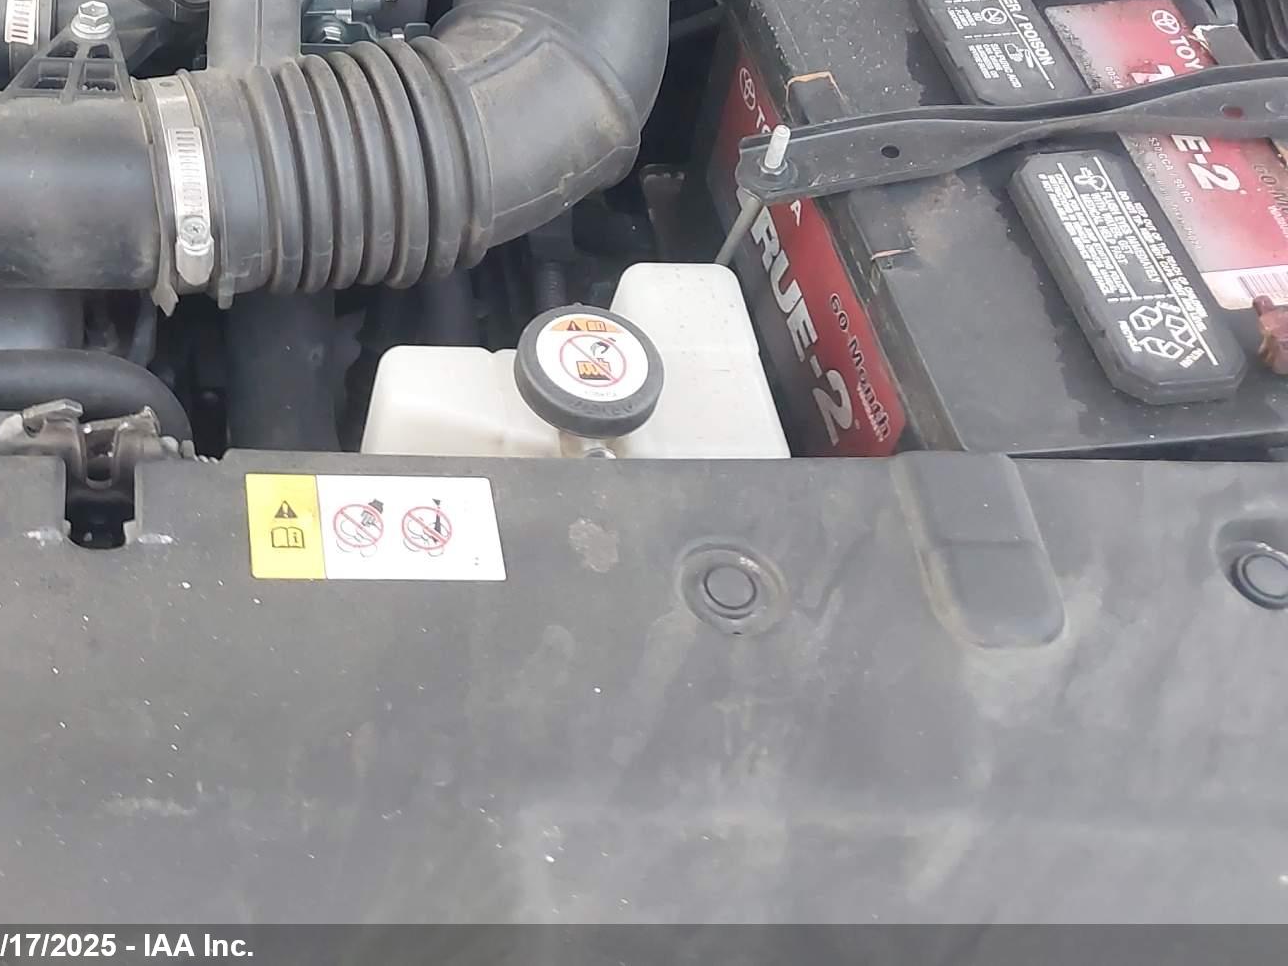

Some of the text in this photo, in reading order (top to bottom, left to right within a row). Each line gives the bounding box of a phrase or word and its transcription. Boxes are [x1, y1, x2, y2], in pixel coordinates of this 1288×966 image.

[1019, 22, 1055, 65] POISON
[1080, 193, 1104, 225] MEDICAL
[1098, 225, 1116, 244] HELP
[1091, 192, 1109, 212] WITH
[1117, 240, 1134, 254] GET
[1100, 192, 1162, 283] FLUSH EYES IMMEDIATELY
[848, 335, 890, 438] Month
